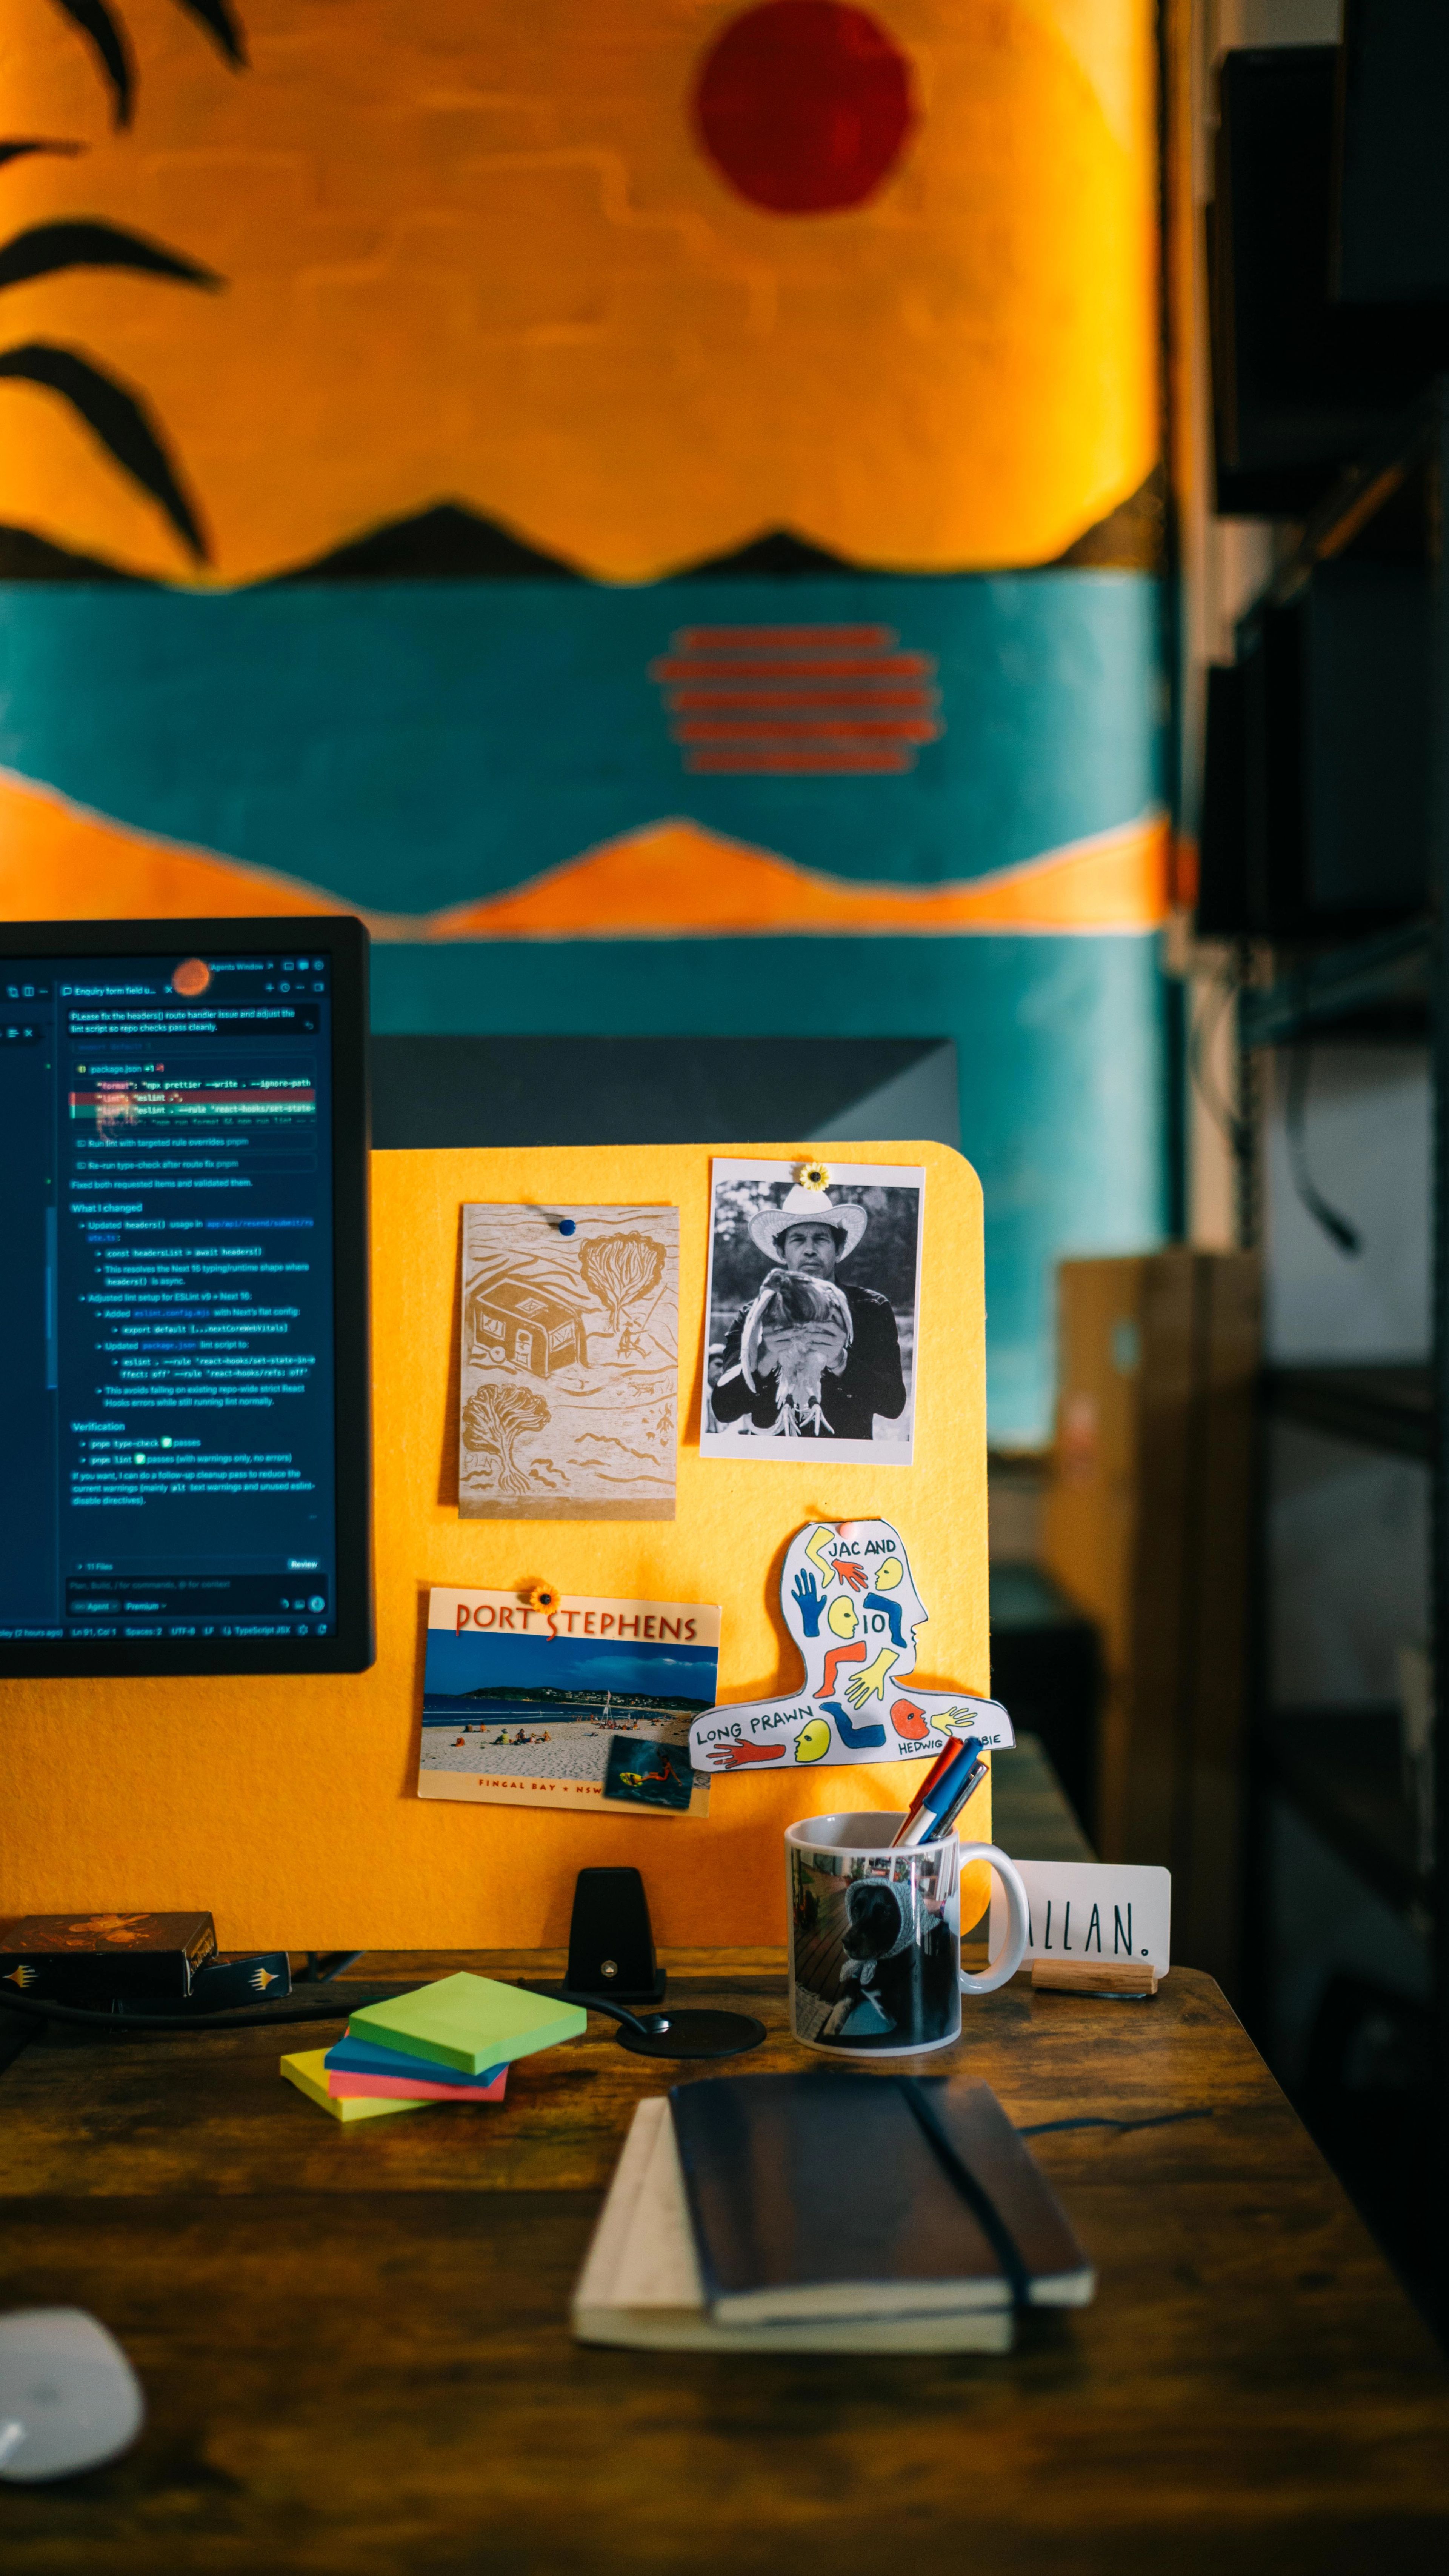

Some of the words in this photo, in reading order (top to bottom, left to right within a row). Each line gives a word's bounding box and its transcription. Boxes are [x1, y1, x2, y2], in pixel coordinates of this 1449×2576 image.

[75, 987, 104, 997] Enquiry
[256, 1009, 280, 1019] adjust
[282, 1009, 295, 1017] the
[85, 1025, 107, 1034] script
[169, 1024, 187, 1033] pass
[188, 1023, 218, 1032] cleanly.
[91, 1066, 142, 1075] package.json
[137, 1140, 170, 1148] targeted
[117, 1161, 161, 1170] type-check
[72, 1204, 97, 1212] What
[102, 1204, 143, 1214] changed
[88, 1222, 122, 1230] Updated
[170, 1221, 194, 1230] usage
[202, 1264, 258, 1274] typing/runtime
[260, 1264, 284, 1272] shape
[88, 1294, 123, 1303] Adjusted
[138, 1294, 160, 1303] setup
[124, 1327, 151, 1335] export
[105, 1343, 139, 1351] Updated
[214, 1341, 237, 1350] script
[151, 1386, 174, 1396] failing
[187, 1386, 218, 1395] existing
[218, 1386, 258, 1394] repo-wide
[194, 1399, 224, 1407] running
[73, 1423, 125, 1431] Verification
[114, 1440, 159, 1449] type-check
[176, 1455, 195, 1463] (with
[197, 1455, 232, 1464] warnings
[233, 1455, 252, 1464] only,
[80, 1473, 95, 1482] you
[158, 1472, 195, 1480] follow-up
[196, 1472, 228, 1480] cleanup
[228, 1472, 248, 1480] pass
[103, 1485, 138, 1493] warnings
[140, 1484, 168, 1493] (mainly
[207, 1484, 242, 1492] warnings
[828, 1541, 861, 1557] JAC
[864, 1539, 896, 1556] AND
[87, 1603, 109, 1612] Agent
[455, 1604, 536, 1637] PORT
[546, 1610, 697, 1642] STEPHENS
[696, 1723, 742, 1746] LONG
[750, 1705, 814, 1734] PRAWN
[898, 1739, 943, 1755] HEDWIG
[479, 1779, 525, 1789] FINGAL
[532, 1782, 556, 1792] BAY
